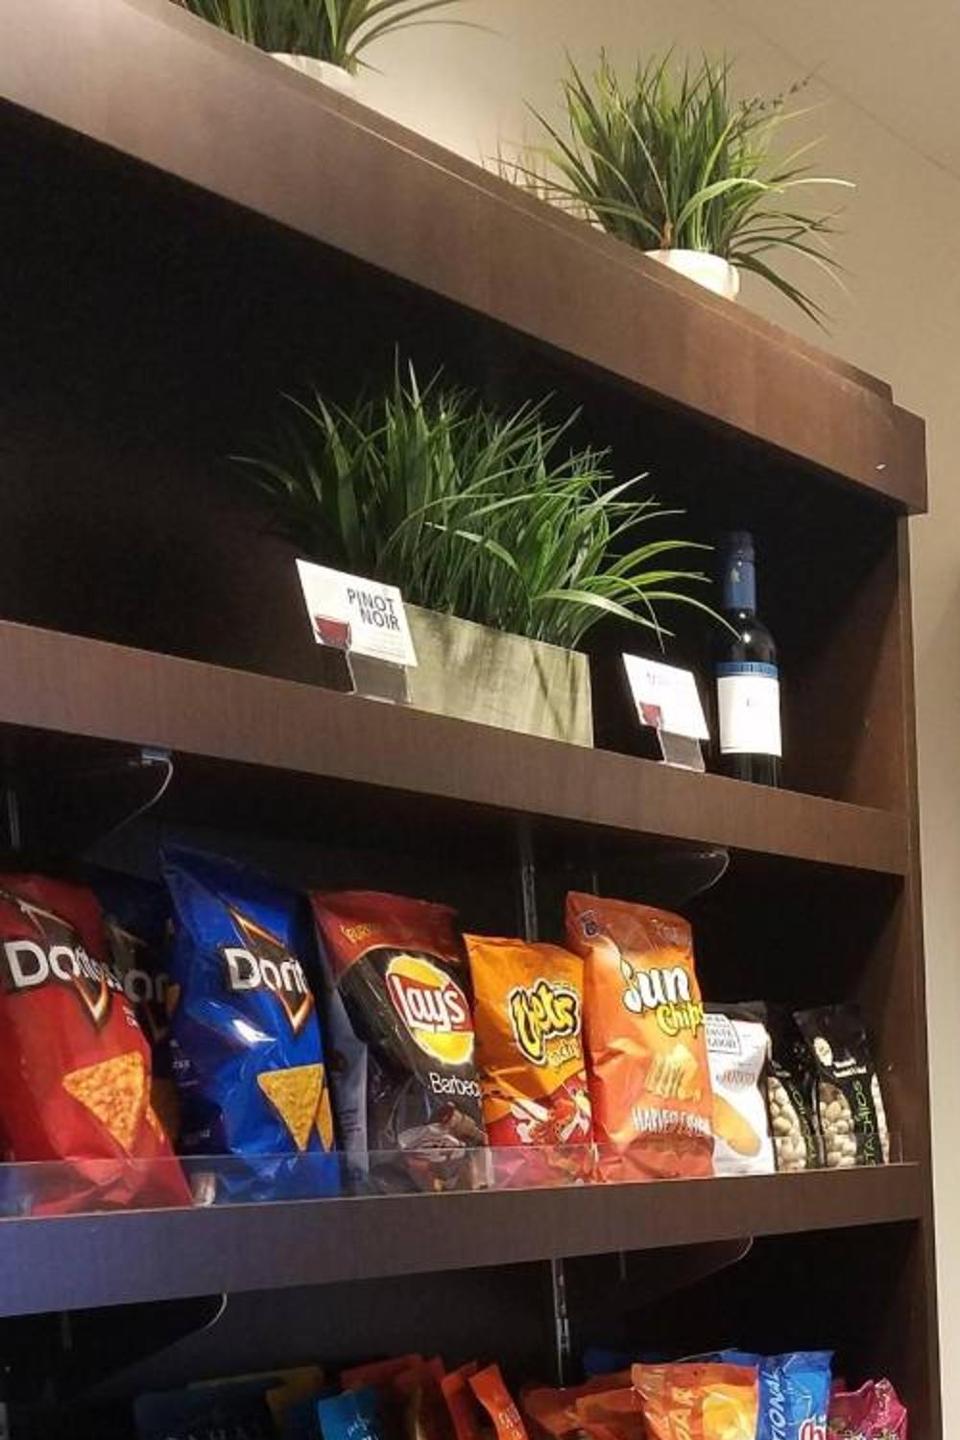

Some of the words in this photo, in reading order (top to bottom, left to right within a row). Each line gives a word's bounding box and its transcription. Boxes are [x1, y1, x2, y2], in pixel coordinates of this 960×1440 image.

[346, 588, 395, 614] PINOT
[360, 608, 400, 631] NOIR
[223, 946, 308, 990] Dorit
[391, 974, 466, 1031] Lay's
